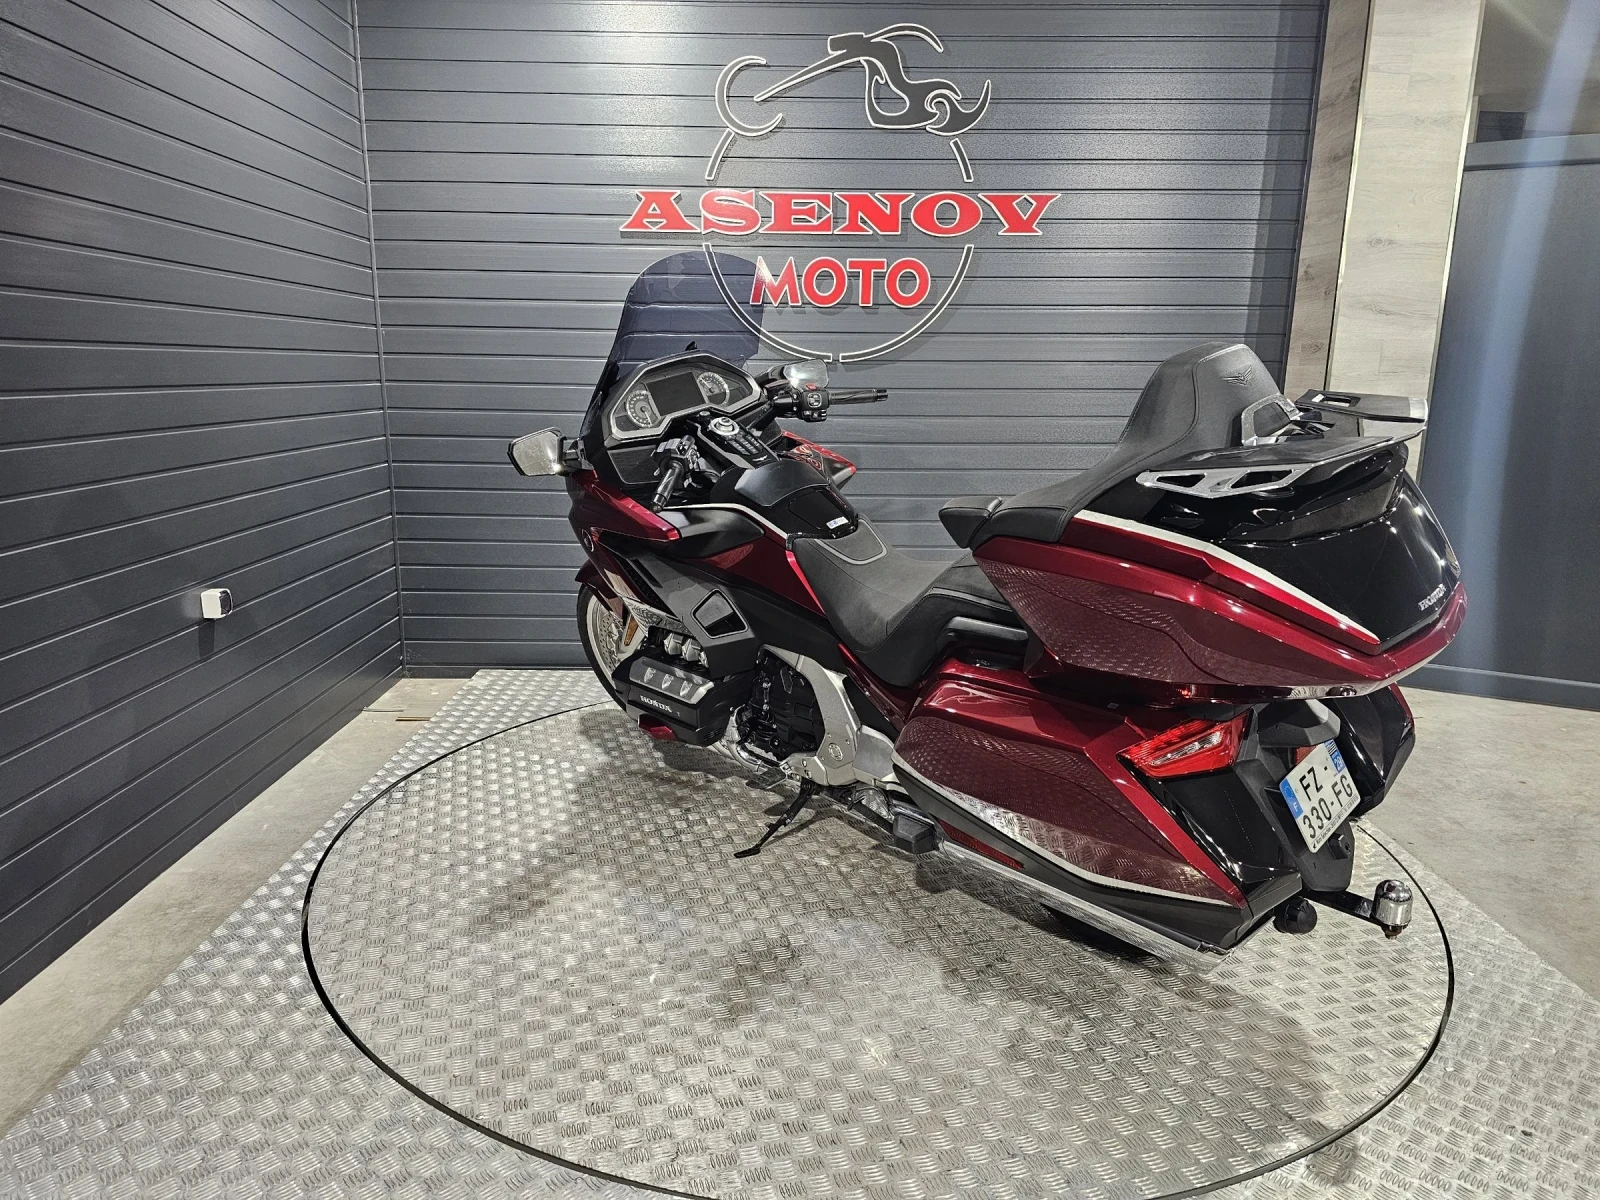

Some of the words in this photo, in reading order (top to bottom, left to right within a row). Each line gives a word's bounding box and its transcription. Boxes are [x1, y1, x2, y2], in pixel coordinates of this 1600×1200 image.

[619, 190, 1061, 237] ASENOV
[749, 256, 931, 308] MOTO
[1418, 583, 1447, 611] HONDA
[640, 695, 673, 713] HONDA
[1303, 774, 1353, 839] 330-FG
